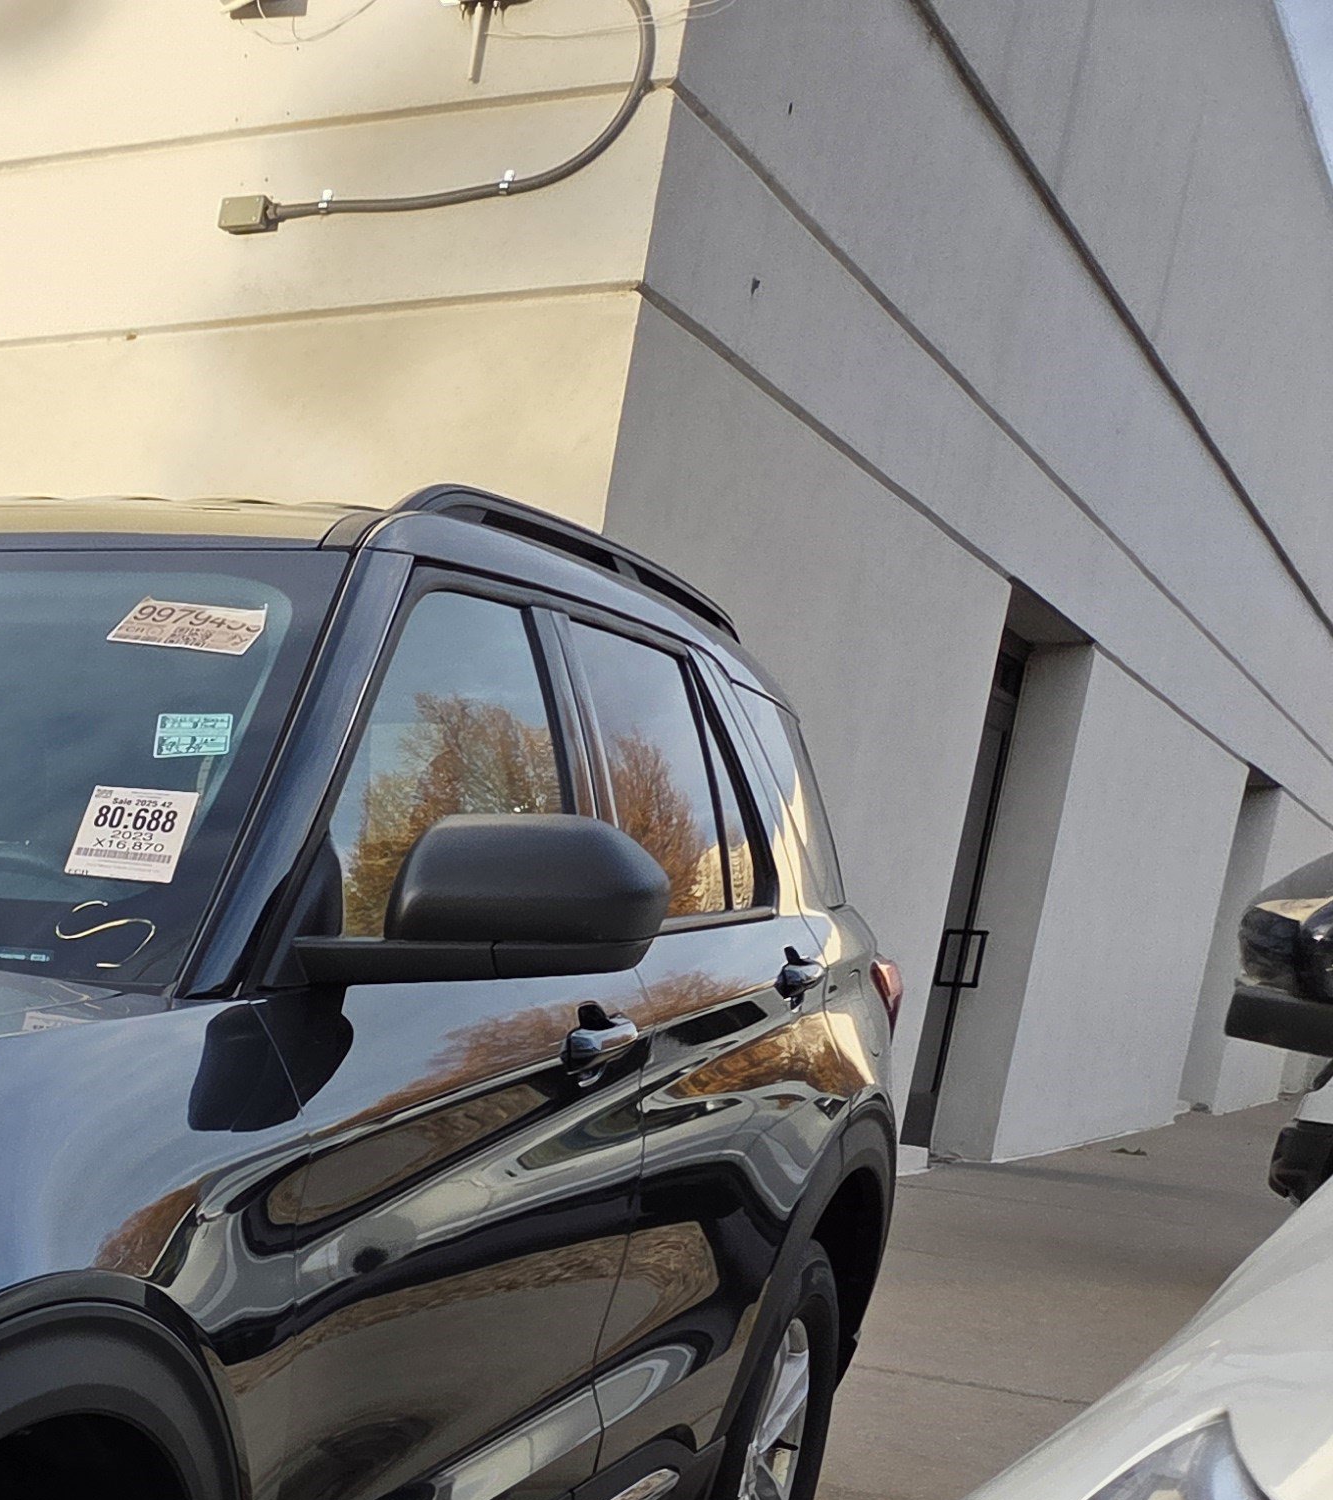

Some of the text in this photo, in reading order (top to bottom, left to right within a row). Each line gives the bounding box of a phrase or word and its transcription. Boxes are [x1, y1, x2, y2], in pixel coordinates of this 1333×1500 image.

[112, 797, 132, 806] Sale
[135, 799, 158, 807] 2025
[94, 805, 178, 833] 80:688
[110, 830, 153, 841] 2023
[93, 837, 164, 853] X16,870
